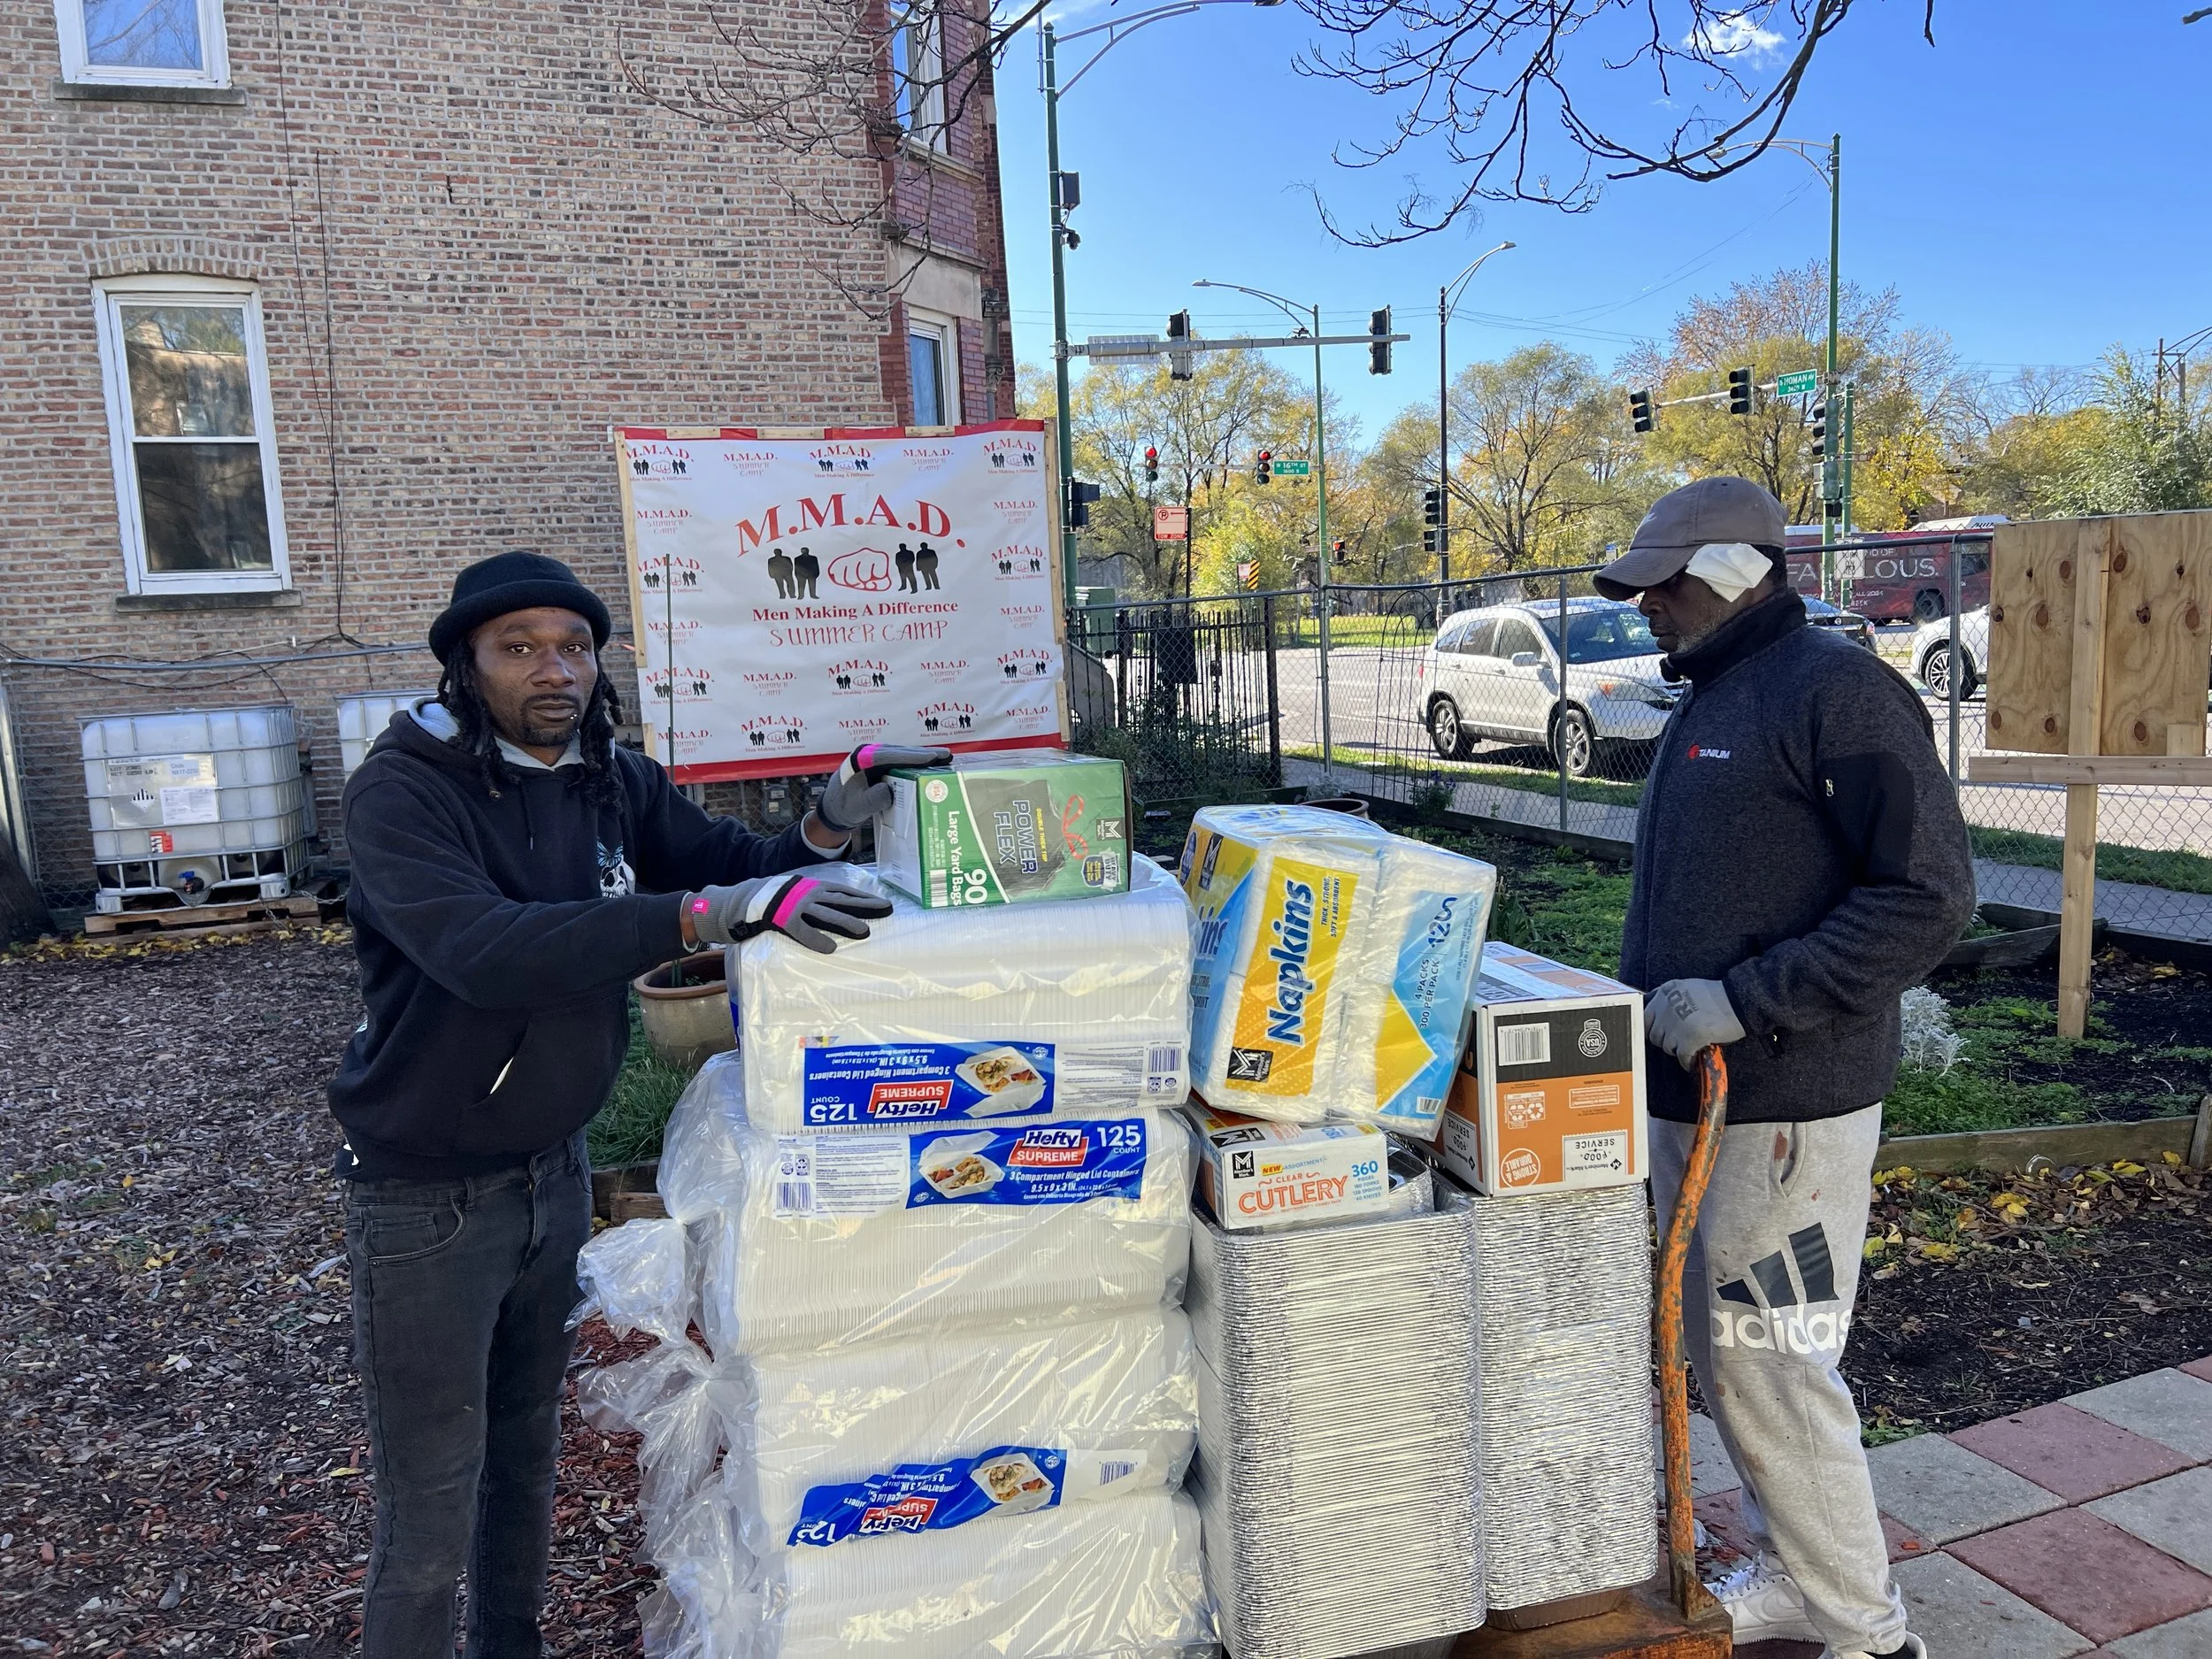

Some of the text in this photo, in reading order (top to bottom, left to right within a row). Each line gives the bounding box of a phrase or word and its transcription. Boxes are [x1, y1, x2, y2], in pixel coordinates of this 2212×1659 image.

[1784, 373, 1808, 386] HOMAN
[810, 445, 876, 460] M.M.A.D.
[902, 448, 954, 457] M.M.A.D.
[983, 438, 1041, 456] M.M.A.D.
[723, 452, 779, 462] M.M.A.D.
[994, 500, 1038, 510] M.M.A.D.
[637, 509, 692, 519] M.M.A.D.
[735, 494, 965, 557] M.M.A.D.
[991, 544, 1047, 562] M.M.A.D.
[753, 602, 958, 622] Men Making A Difference
[1001, 605, 1045, 615] M.M.A.D.
[770, 619, 948, 648] SUMMER CAMP
[921, 660, 969, 670] M.M.A.D.
[997, 649, 1053, 666] M.M.A.D.
[743, 672, 797, 682] M.M.A.D.
[828, 659, 893, 678] M.M.A.D.
[917, 702, 979, 720] M.M.A.D.
[1005, 705, 1050, 718] M.M.A.D.
[741, 715, 808, 733] M.M.A.D.
[839, 718, 889, 728] M.M.A.D.
[658, 729, 713, 741] MM.A.D.
[994, 811, 1017, 864] FLEX
[1012, 800, 1038, 874] POWER
[947, 810, 964, 906] Large Yard Bags
[964, 868, 988, 904] 90
[1332, 877, 1341, 914] ABSORBENT
[1320, 904, 1329, 926] THICK,
[1266, 879, 1314, 1045] Napkins
[1417, 958, 1430, 992] PACKS
[1419, 959, 1440, 1028] 300 PER PACK
[1586, 1038, 1600, 1048] USA
[878, 1057, 888, 1066] IN.
[888, 1056, 895, 1065] 3
[902, 1056, 908, 1065] 9
[915, 1055, 928, 1064] 9.5
[1255, 1051, 1266, 1081] Member's
[1261, 1058, 1271, 1078] Mark
[809, 1064, 951, 1080] 3 Compartment Hinged Lid Containers
[879, 1086, 945, 1099] SUPREME
[810, 1103, 858, 1123] 125
[878, 1102, 937, 1117] Hefty
[1097, 1125, 1141, 1147] 125
[1448, 1118, 1470, 1139] SERVICE
[1025, 1131, 1079, 1148] Hefty
[1453, 1136, 1466, 1150] FOOD
[1575, 1138, 1616, 1149] SERVICE
[1017, 1150, 1079, 1162] SUPREME
[1504, 1153, 1532, 1172] DURABLE
[1584, 1150, 1608, 1162] FOOD
[1009, 1168, 1140, 1183] 3 Compartment Hinged Lid Containers
[1351, 1160, 1379, 1177] 360
[1506, 1163, 1538, 1183] STRONG &
[1276, 1172, 1303, 1183] CLEAR
[1031, 1183, 1042, 1193] 9.5
[1239, 1175, 1348, 1214] CUTLERY
